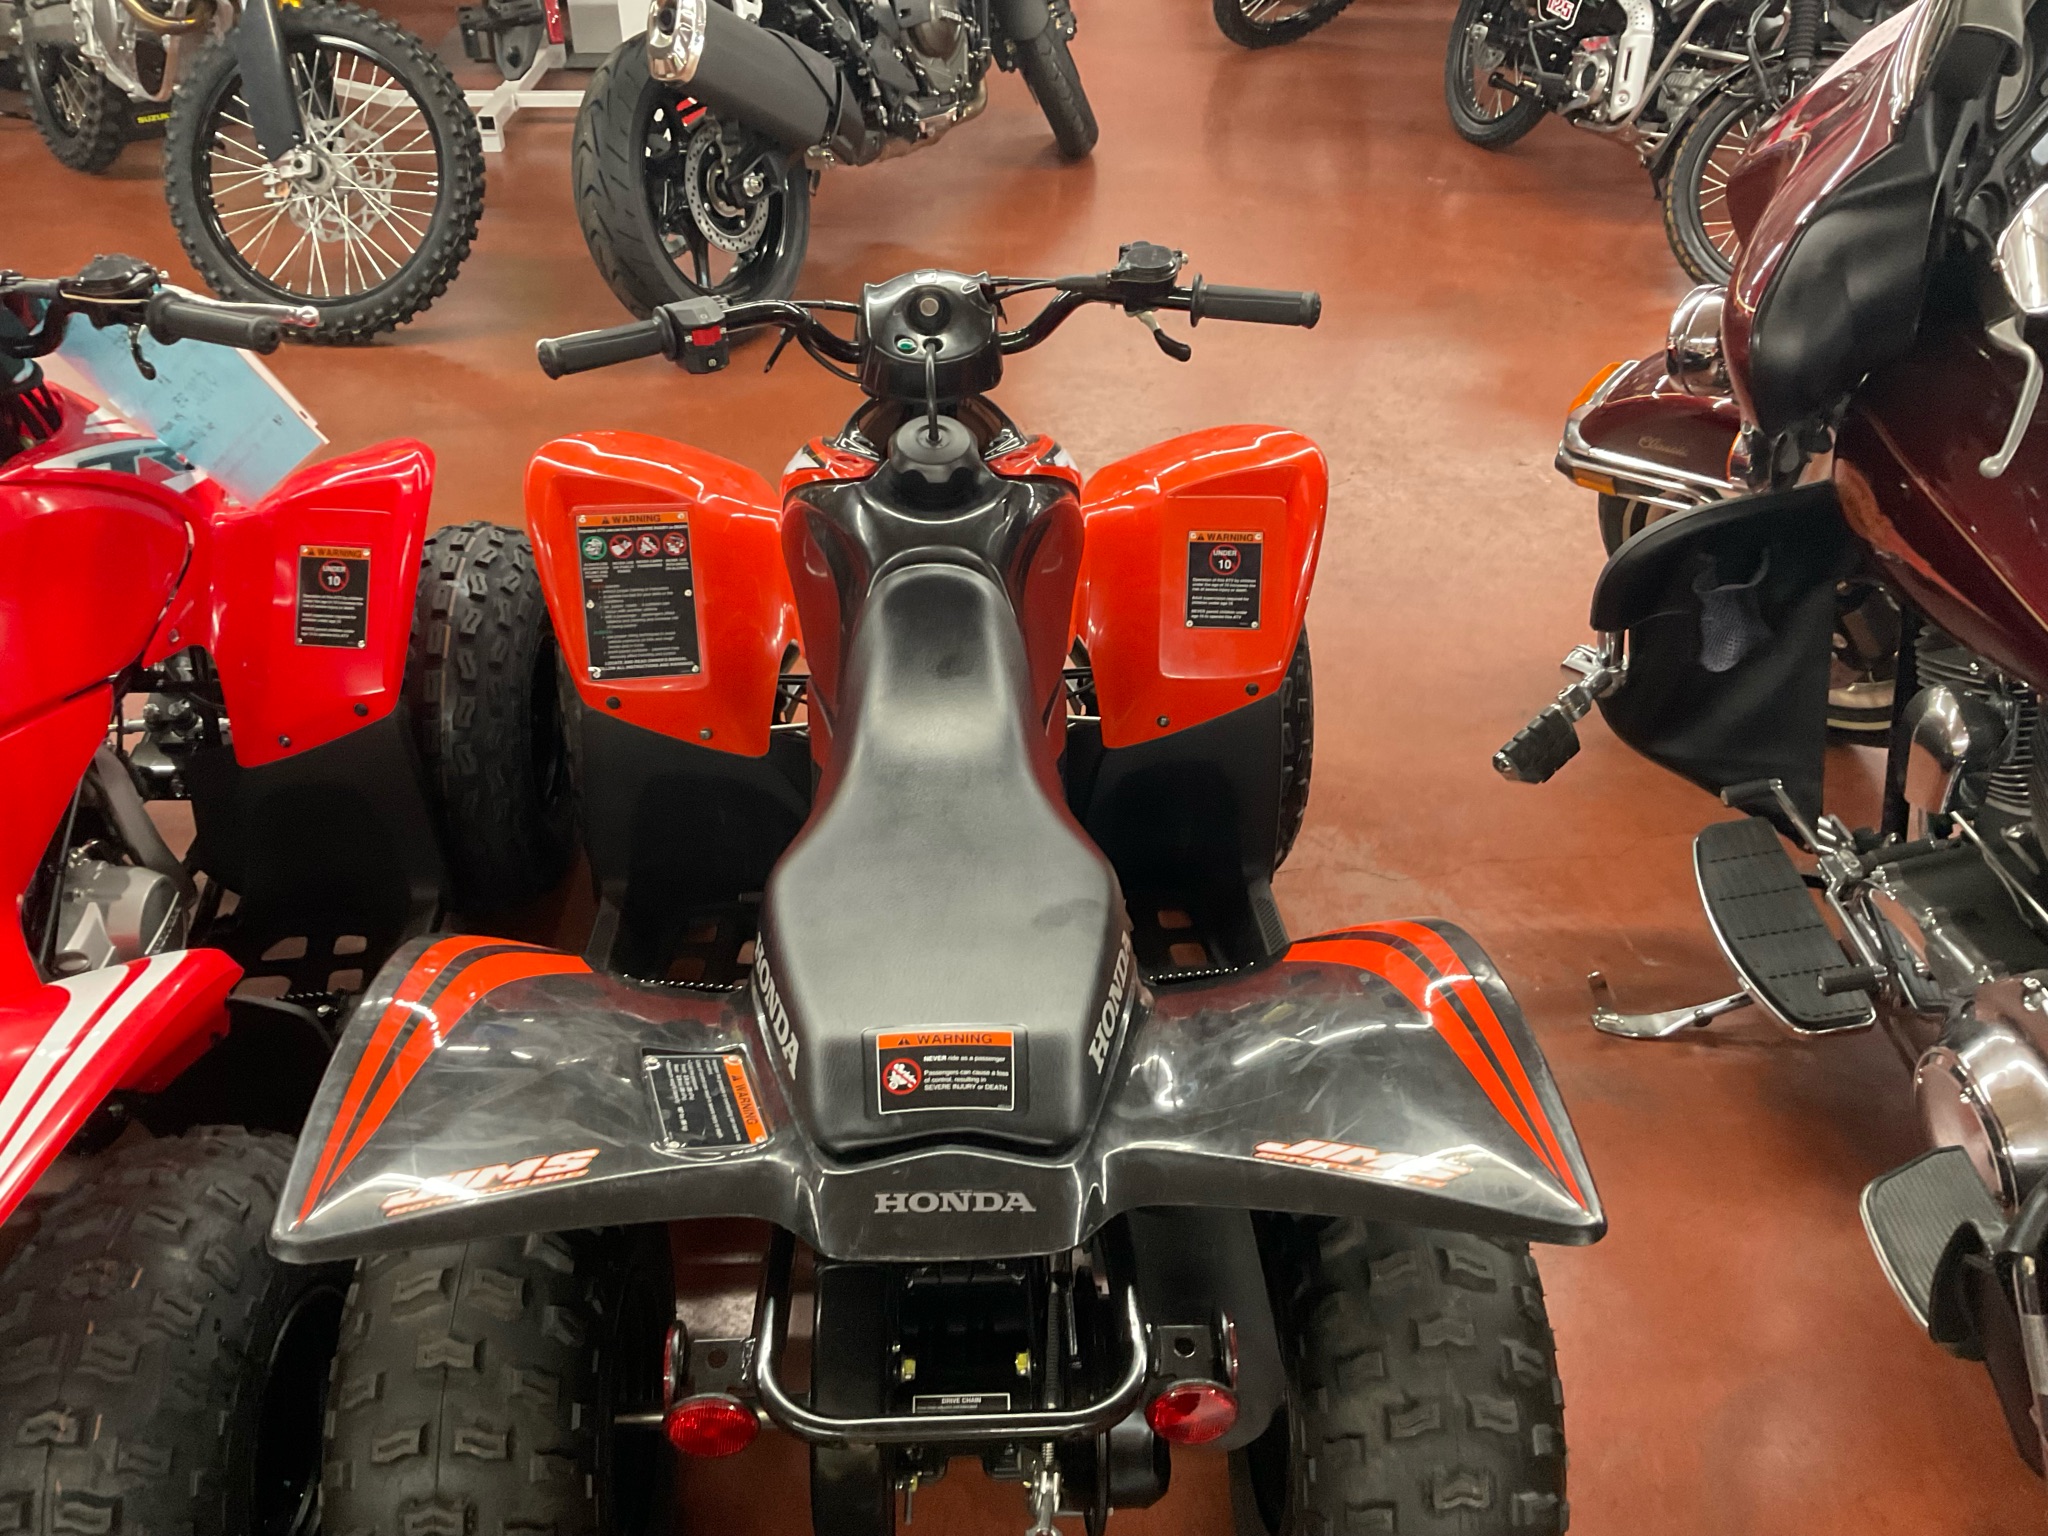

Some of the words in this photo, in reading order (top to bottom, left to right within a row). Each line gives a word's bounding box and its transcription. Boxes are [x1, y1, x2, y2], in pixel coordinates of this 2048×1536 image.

[1546, 0, 1575, 21] 125
[137, 112, 171, 123] SUZUK
[612, 514, 661, 524] WARNING
[1207, 533, 1254, 541] WARNING
[317, 549, 362, 558] WARNING
[1218, 559, 1232, 570] 10
[327, 575, 341, 586] 10
[755, 931, 799, 1080] HONDA
[1088, 930, 1131, 1075] HONDA
[917, 1034, 993, 1044] WARNING
[924, 1083, 951, 1091] SEVERE
[984, 1083, 1008, 1091] DEATH
[736, 1084, 758, 1125] WARNING
[874, 1191, 1037, 1213] HONDA
[961, 1396, 982, 1404] CHAIN
